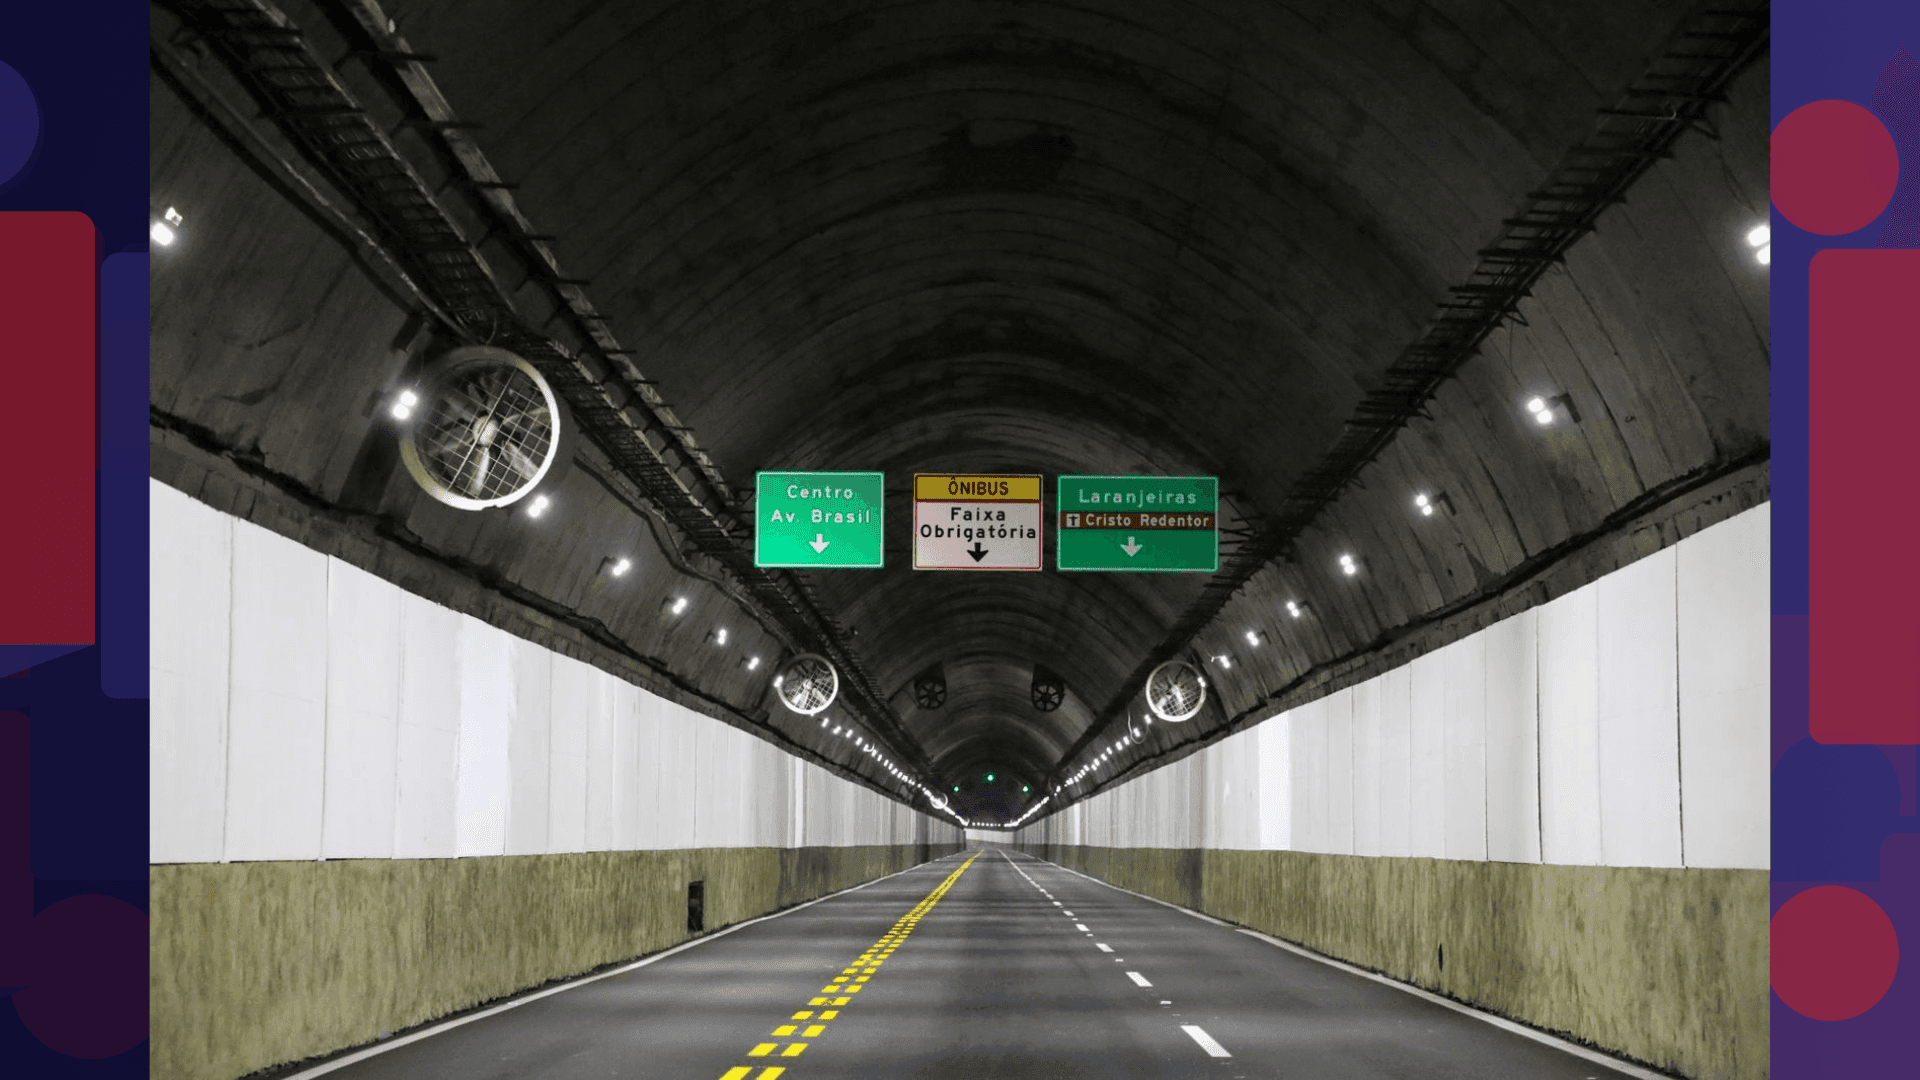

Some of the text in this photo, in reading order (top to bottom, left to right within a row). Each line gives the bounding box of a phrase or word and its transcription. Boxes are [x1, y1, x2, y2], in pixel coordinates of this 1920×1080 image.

[787, 485, 853, 499] Centro
[948, 476, 1009, 496] ÔNIBUS
[1079, 489, 1197, 508] Laranjeiras
[770, 508, 870, 523] Av. Brasil
[951, 507, 1006, 521] Faixa
[1085, 513, 1210, 528] Cristo Redentor
[920, 524, 1036, 542] Obrigatória
